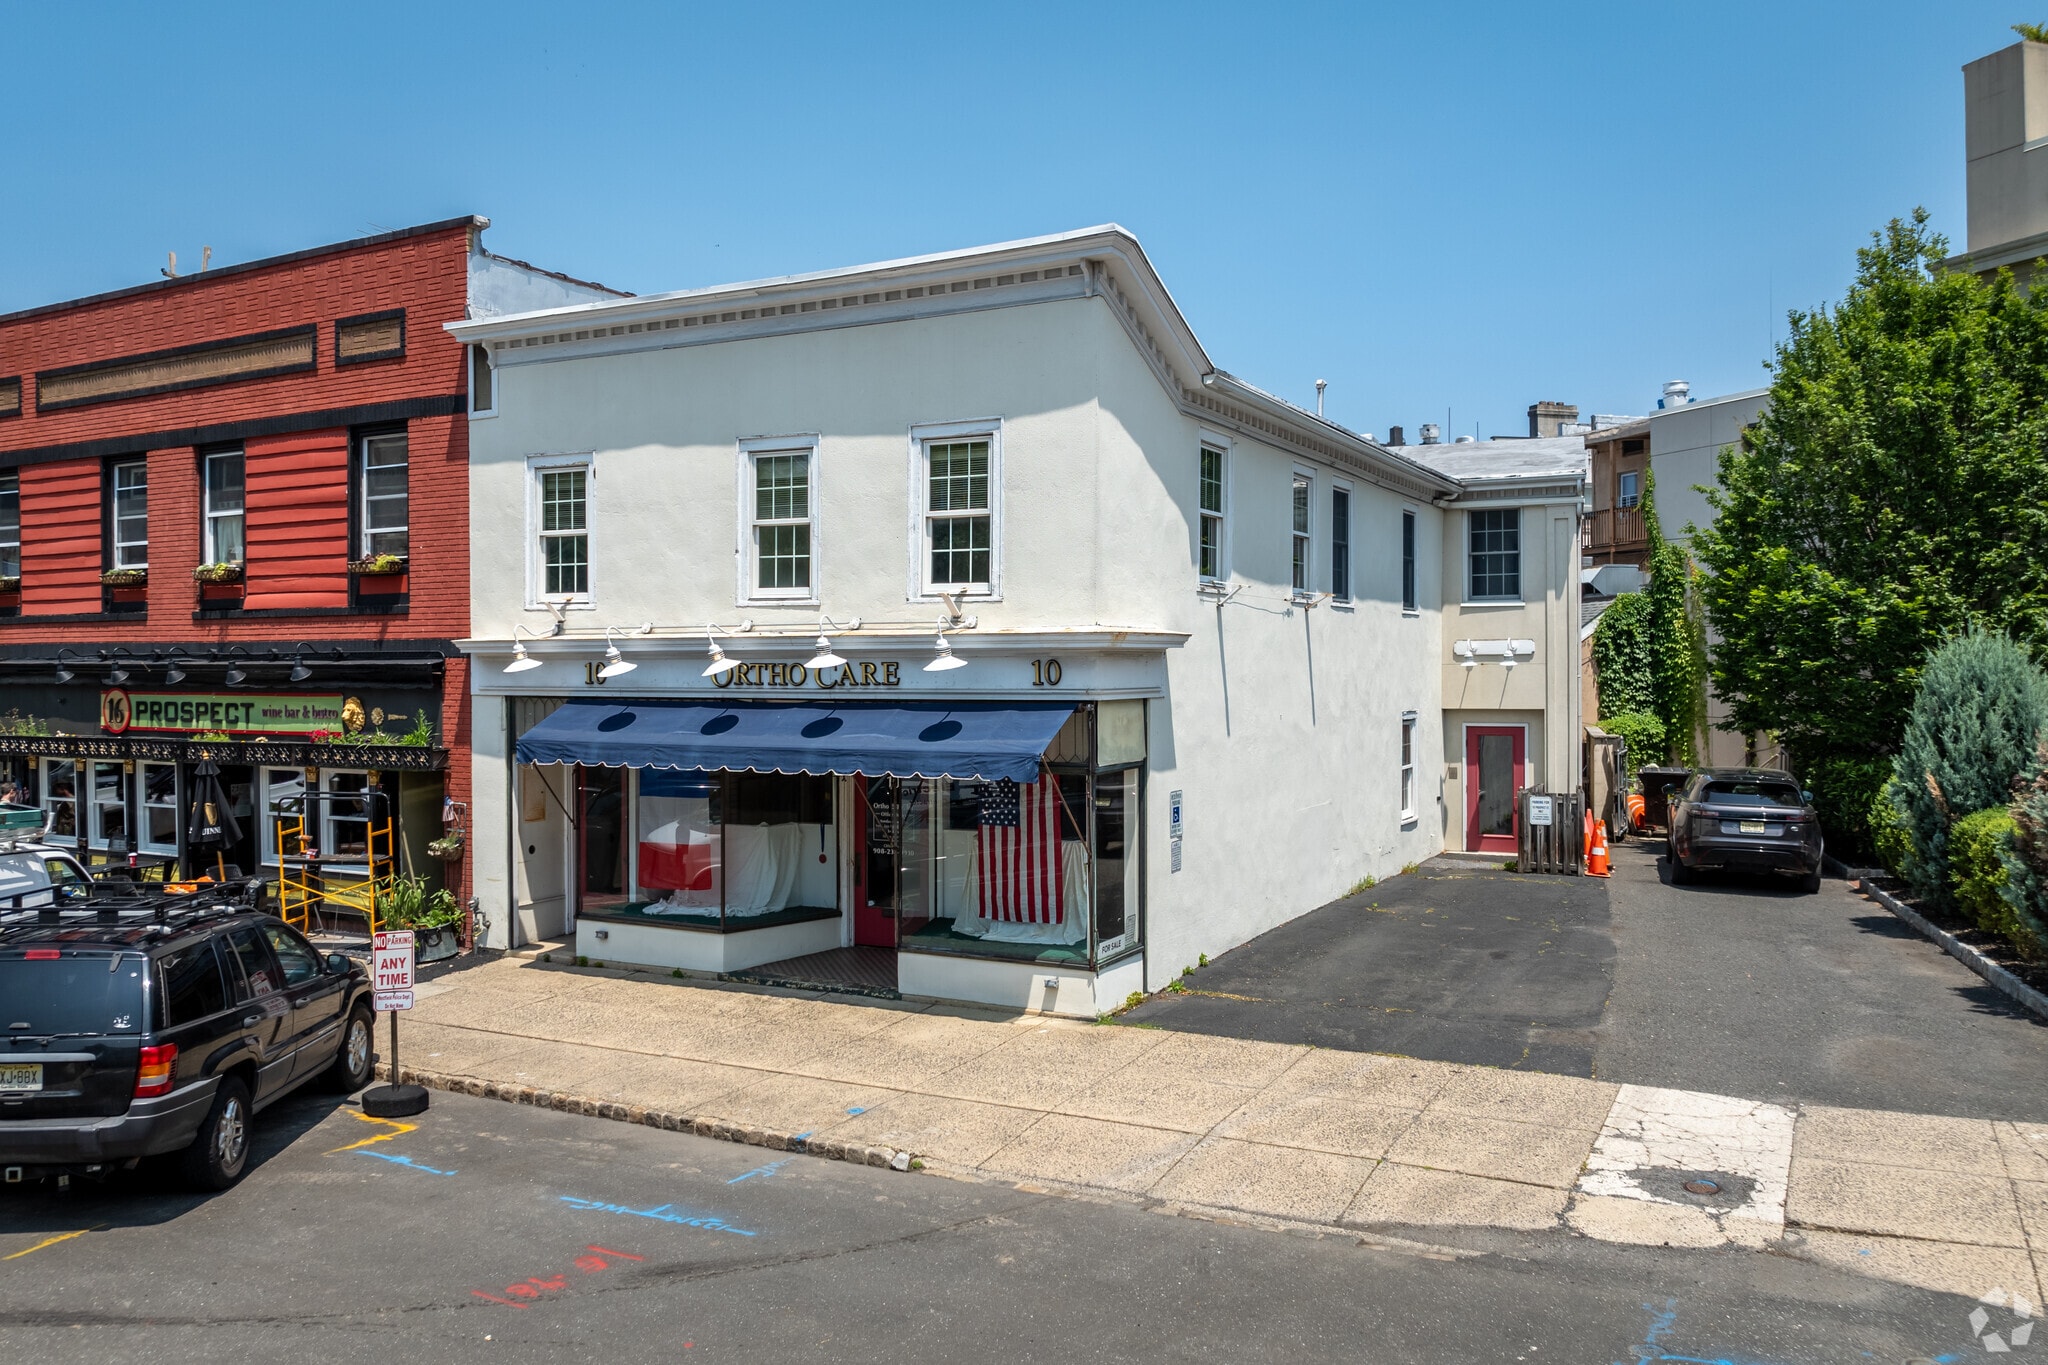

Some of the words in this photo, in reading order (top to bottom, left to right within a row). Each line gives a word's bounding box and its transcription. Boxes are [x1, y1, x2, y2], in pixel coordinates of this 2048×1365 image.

[814, 660, 900, 689] CARE
[1031, 659, 1062, 686] 10
[108, 698, 125, 724] 16
[135, 701, 255, 725] PROSPECT
[261, 705, 282, 718] wine
[284, 704, 300, 719] bar
[302, 705, 310, 719] &
[312, 705, 339, 719] bistro
[375, 936, 386, 948] NO
[387, 936, 412, 946] PARKING
[1101, 944, 1111, 954] FOR
[1111, 939, 1122, 951] SALE
[380, 957, 406, 970] ANY
[378, 973, 408, 986] TIME
